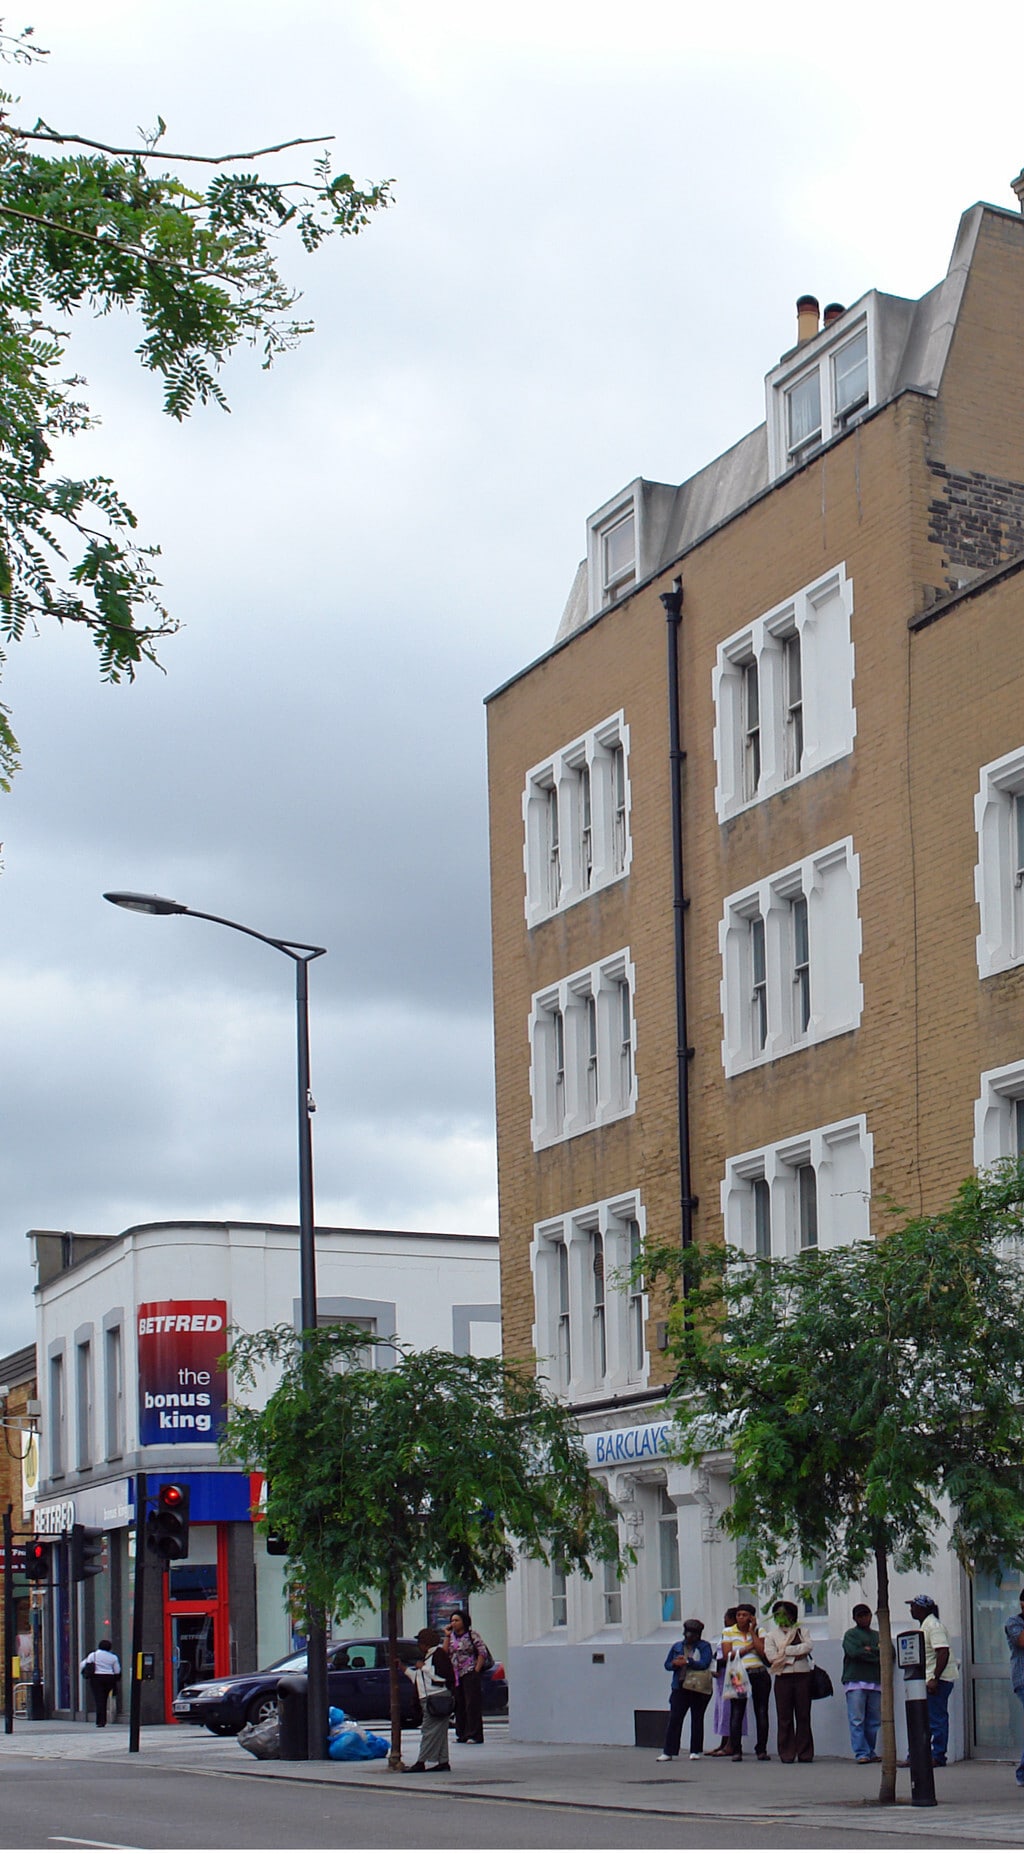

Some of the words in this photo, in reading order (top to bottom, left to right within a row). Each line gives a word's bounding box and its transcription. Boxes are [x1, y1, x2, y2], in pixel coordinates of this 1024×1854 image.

[139, 1315, 223, 1336] BETFRED
[178, 1368, 211, 1386] the
[144, 1392, 211, 1409] bonus
[160, 1411, 212, 1431] king
[596, 1425, 669, 1463] BARCLAYS
